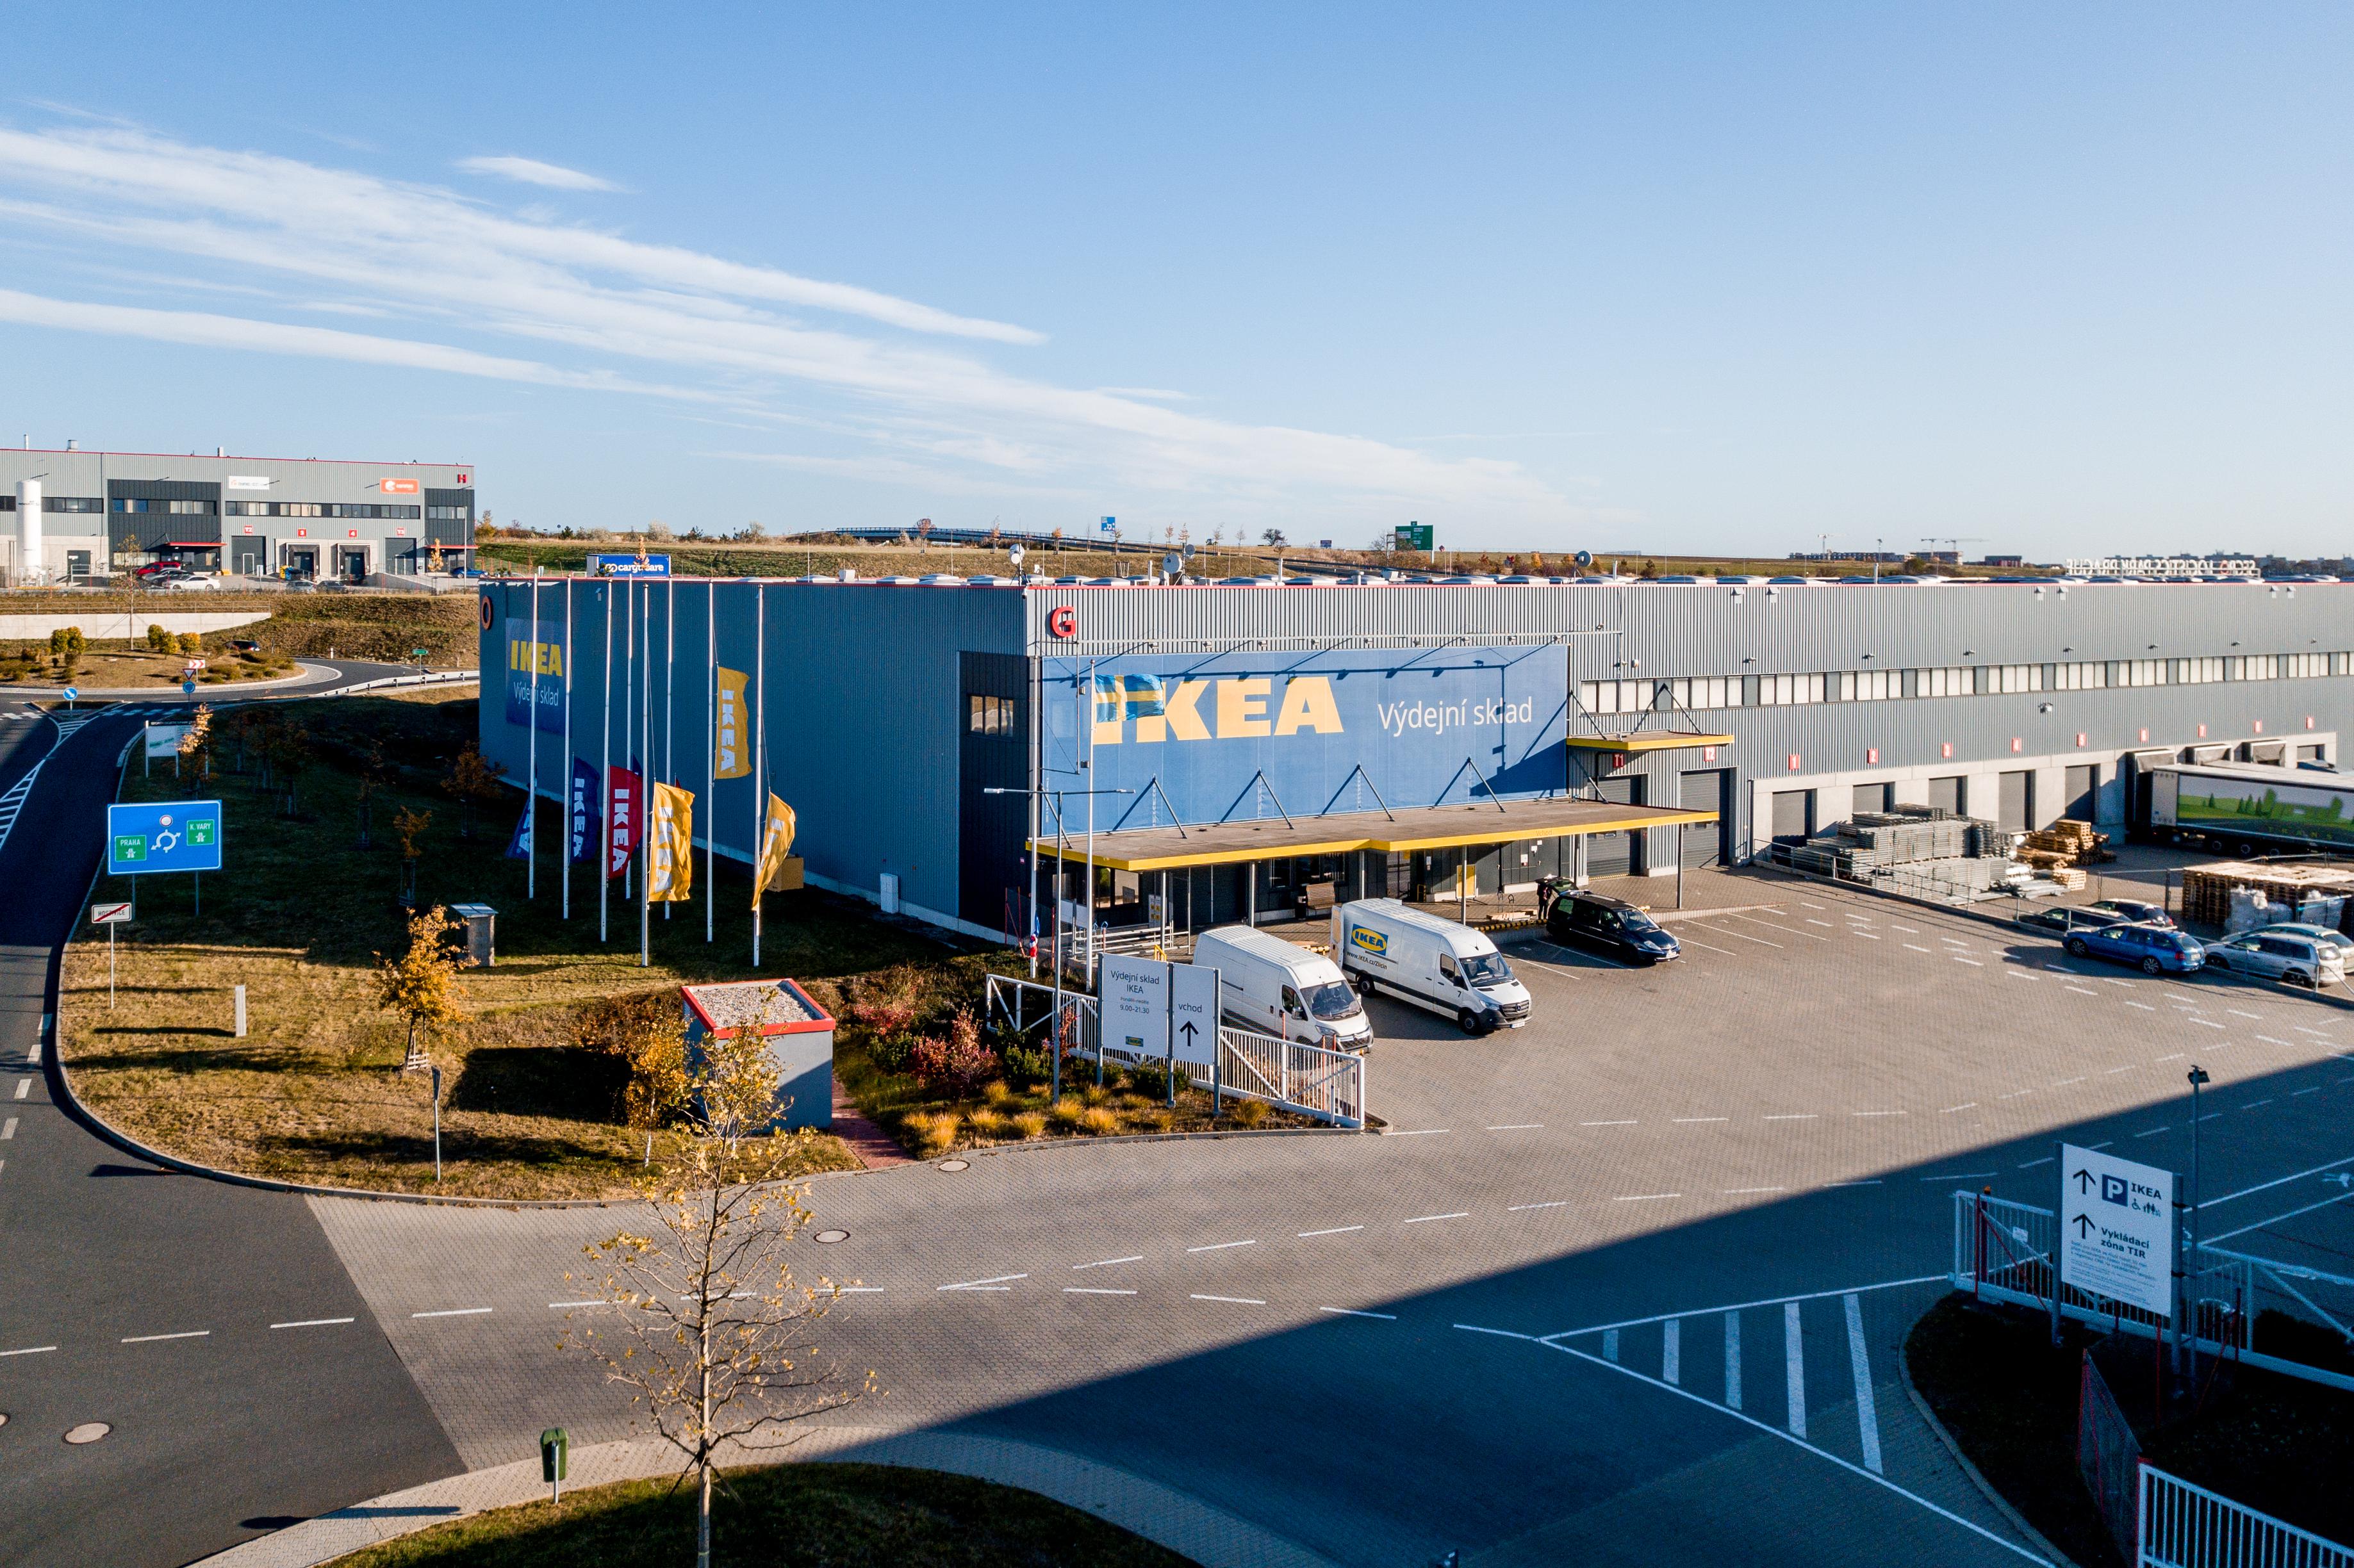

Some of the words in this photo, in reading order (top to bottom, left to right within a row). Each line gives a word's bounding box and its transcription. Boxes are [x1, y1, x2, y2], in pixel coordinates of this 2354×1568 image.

[457, 474, 466, 483] H
[1050, 606, 1076, 637] G
[540, 685, 559, 706] sklad
[1378, 698, 1467, 737] Výdejní
[1474, 696, 1532, 725] sklad
[721, 689, 736, 771] IKEA
[1614, 754, 1624, 767] T1
[1706, 747, 1715, 759] T2
[573, 778, 586, 857] IKEA
[613, 788, 630, 872] IKEA
[1354, 931, 1383, 949] IKEA
[1110, 970, 1139, 983] Výdejní
[1140, 974, 1159, 984] sklad
[1126, 984, 1144, 994] IKEA
[1178, 1002, 1202, 1013] vchod
[2107, 1179, 2123, 1199] P
[2131, 1182, 2162, 1200] IKEA
[2101, 1227, 2150, 1249] Vykládací
[2101, 1239, 2125, 1252] zóna
[2127, 1246, 2146, 1259] TIR
